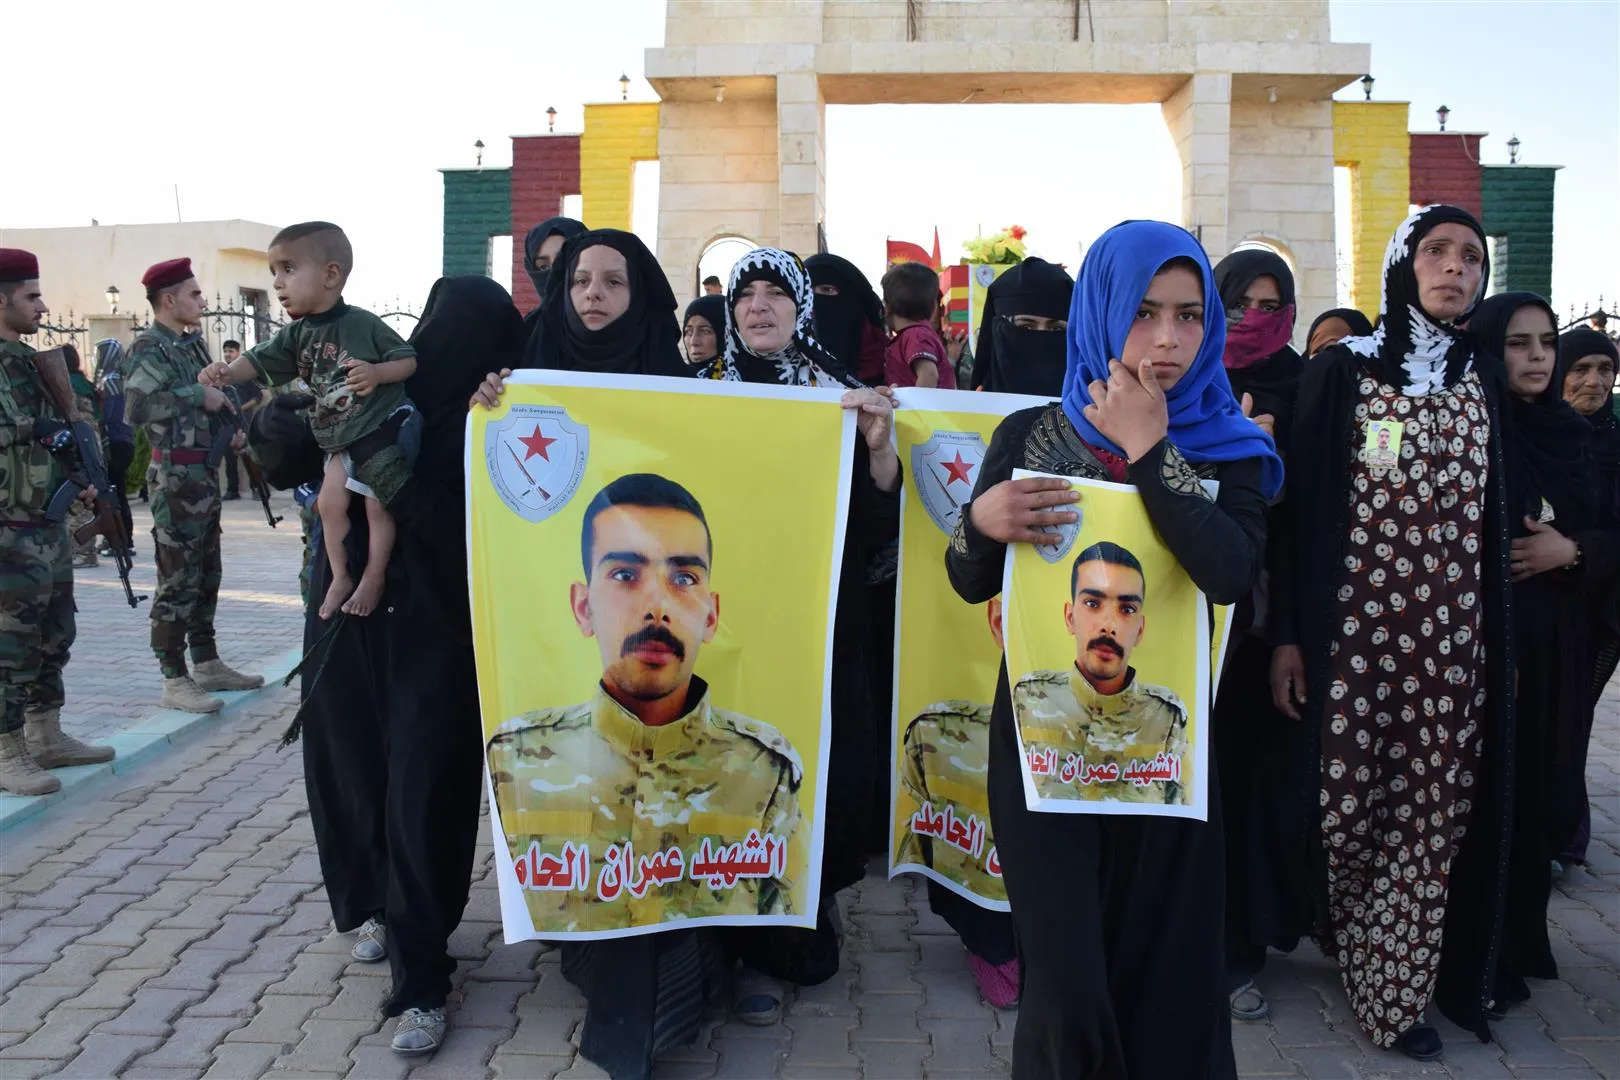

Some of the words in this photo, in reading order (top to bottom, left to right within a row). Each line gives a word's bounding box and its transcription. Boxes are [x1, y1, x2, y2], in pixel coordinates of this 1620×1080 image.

[1026, 747, 1057, 773] الحا
[1061, 754, 1119, 784] عمران
[1123, 752, 1180, 785] الشهيد
[912, 804, 984, 858] الحامد
[514, 844, 590, 887] الحام
[599, 846, 683, 898] عمران
[690, 831, 786, 887] الشهيد
